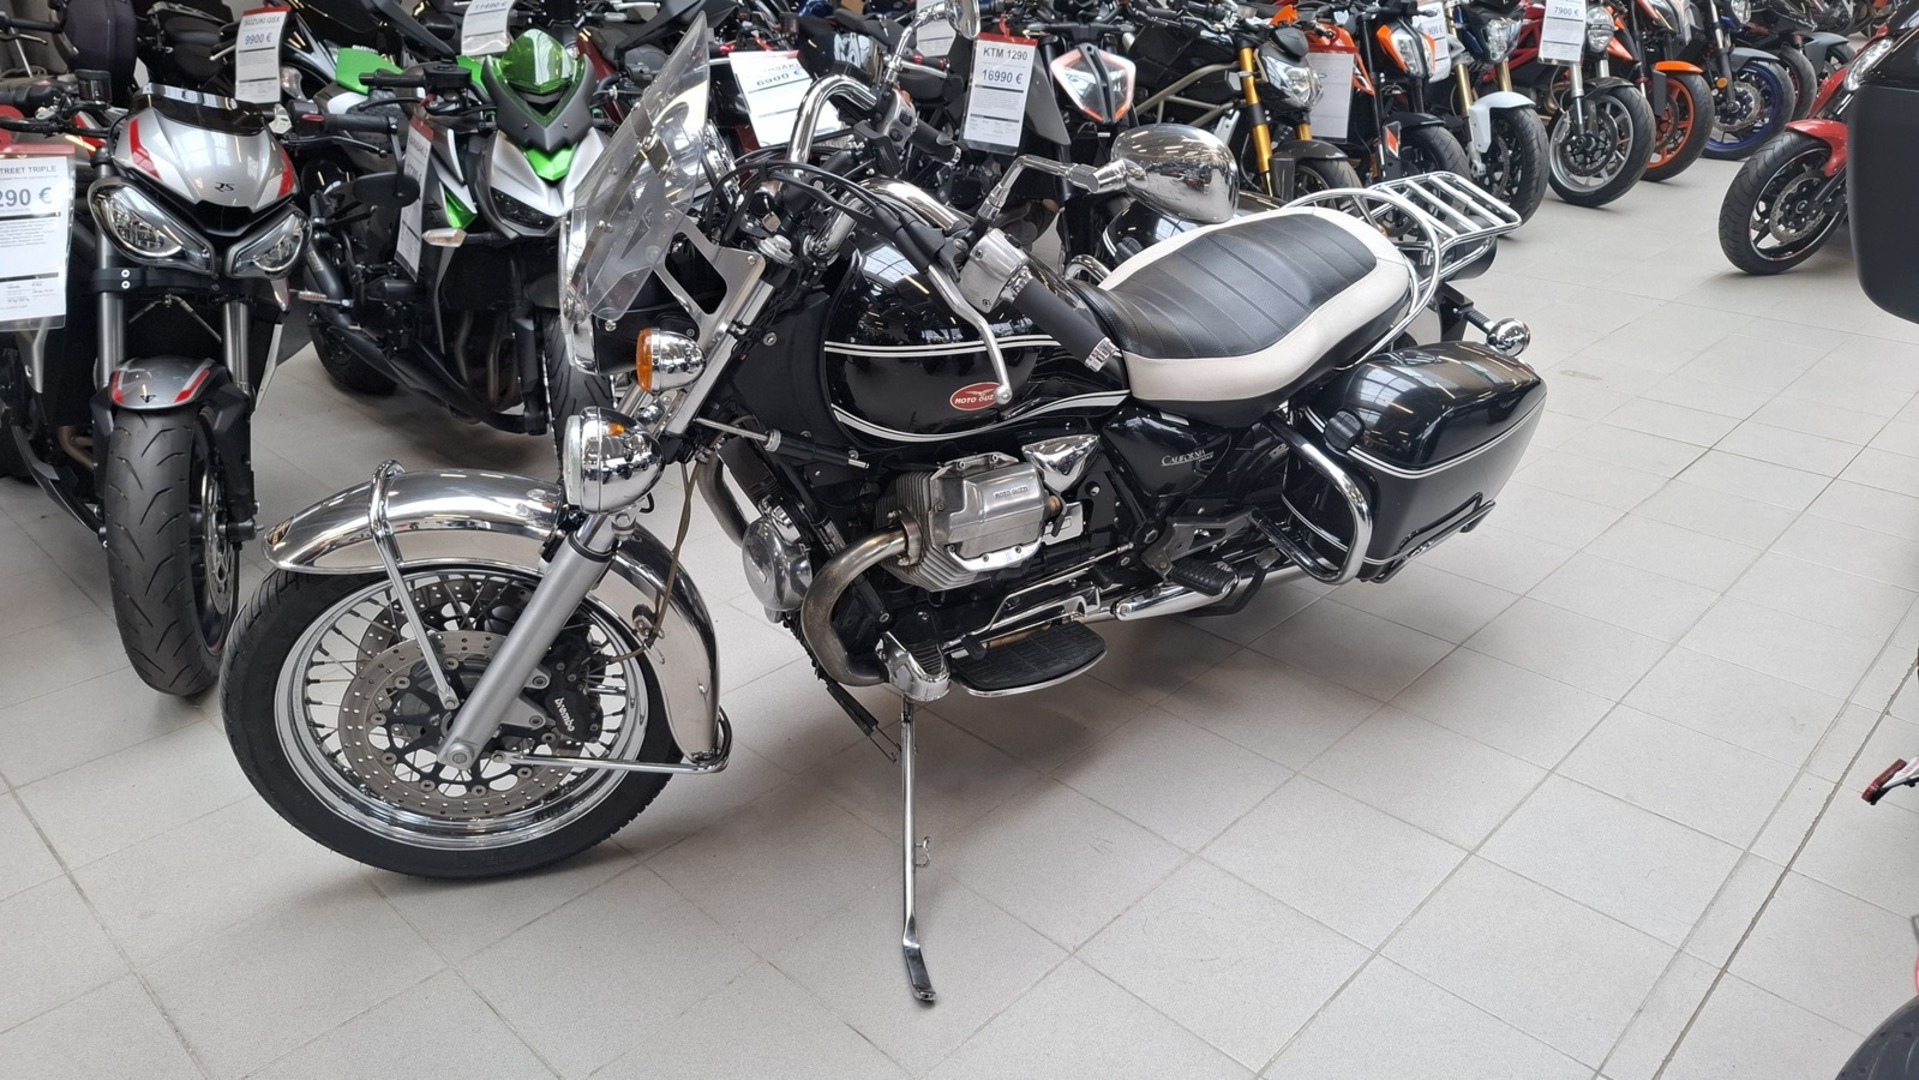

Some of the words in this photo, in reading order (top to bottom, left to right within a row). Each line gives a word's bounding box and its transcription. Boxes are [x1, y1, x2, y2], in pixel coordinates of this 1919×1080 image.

[245, 33, 265, 45] 9900
[266, 32, 272, 43] €
[983, 47, 1004, 58] KTM
[1007, 49, 1028, 61] 1290
[982, 69, 1013, 83] 16990
[1015, 73, 1023, 84] €
[0, 167, 25, 175] TREET
[29, 165, 56, 173] TRIPLE
[38, 187, 52, 204] €
[978, 394, 995, 402] GUZ
[994, 490, 1011, 498] MOTO
[1012, 486, 1028, 495] GUZZI
[554, 697, 576, 732] brembo
